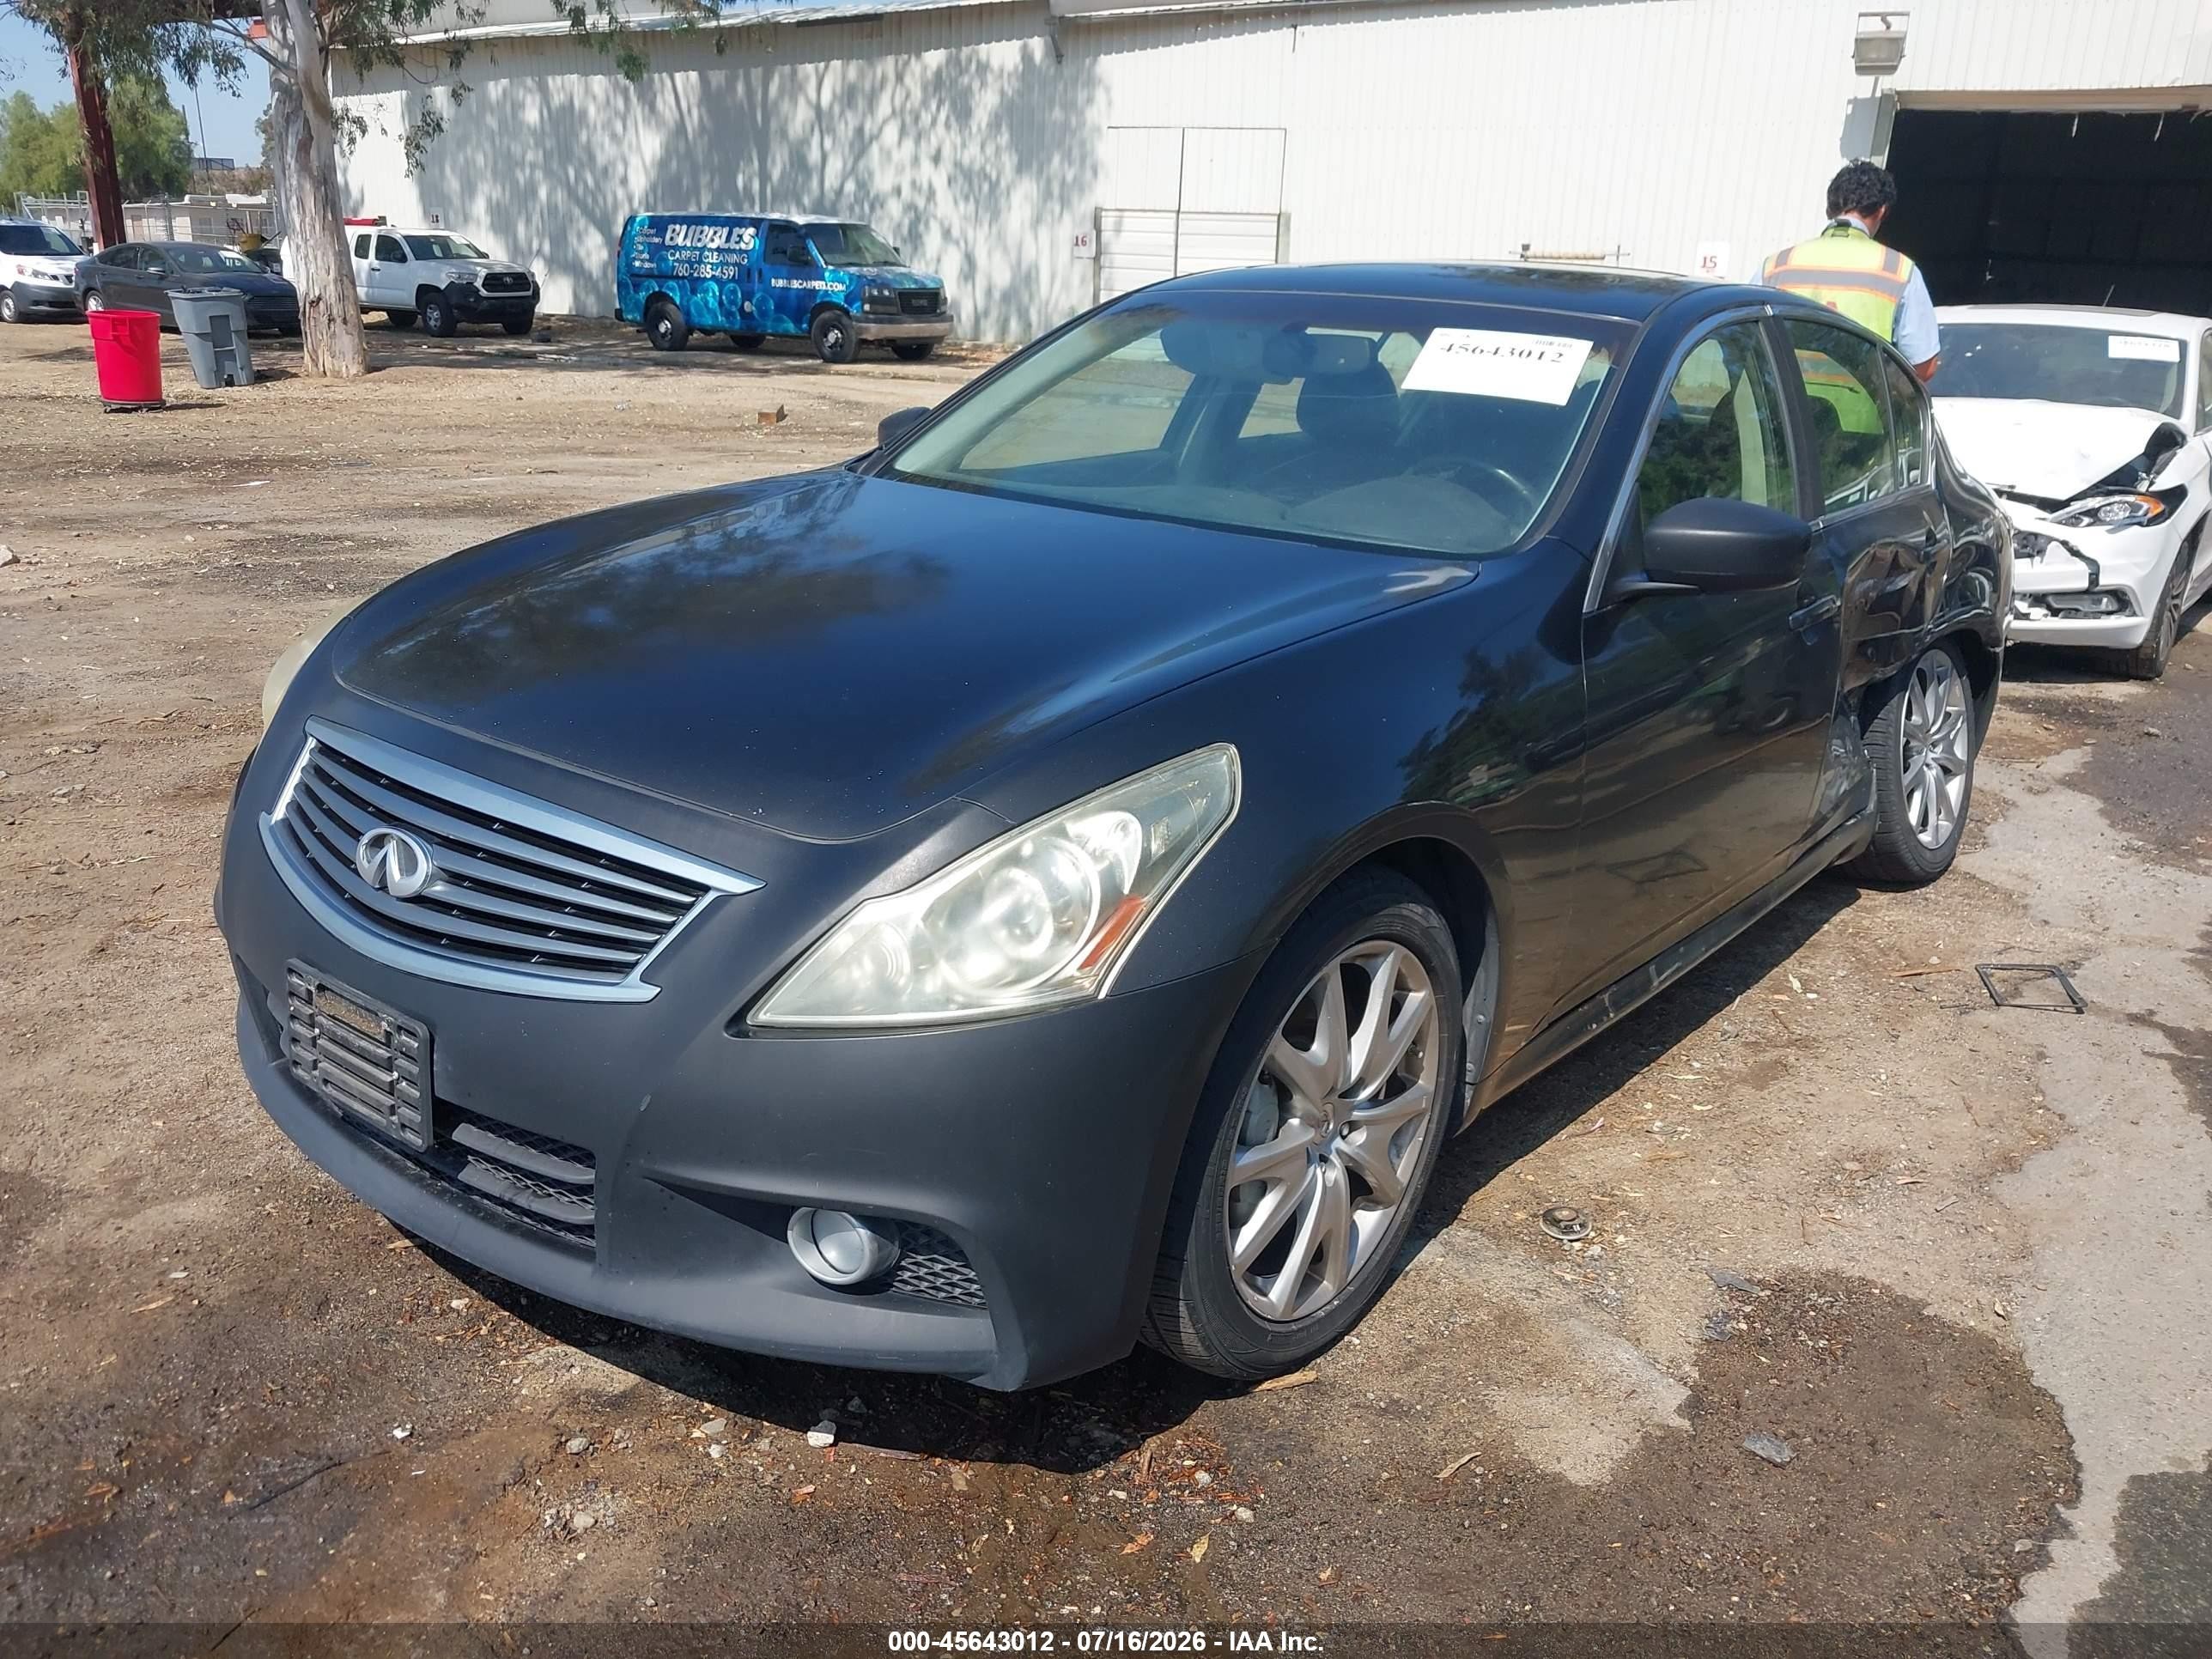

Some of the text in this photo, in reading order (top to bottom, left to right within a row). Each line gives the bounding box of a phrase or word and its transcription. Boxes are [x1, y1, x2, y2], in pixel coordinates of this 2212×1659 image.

[665, 224, 757, 250] BUBBLES
[1074, 235, 1087, 246] 16
[668, 250, 748, 264] CARPET CLEANING
[1701, 256, 1717, 269] 15
[673, 263, 738, 280] 760-285-4591
[1440, 343, 1564, 363] 45643012
